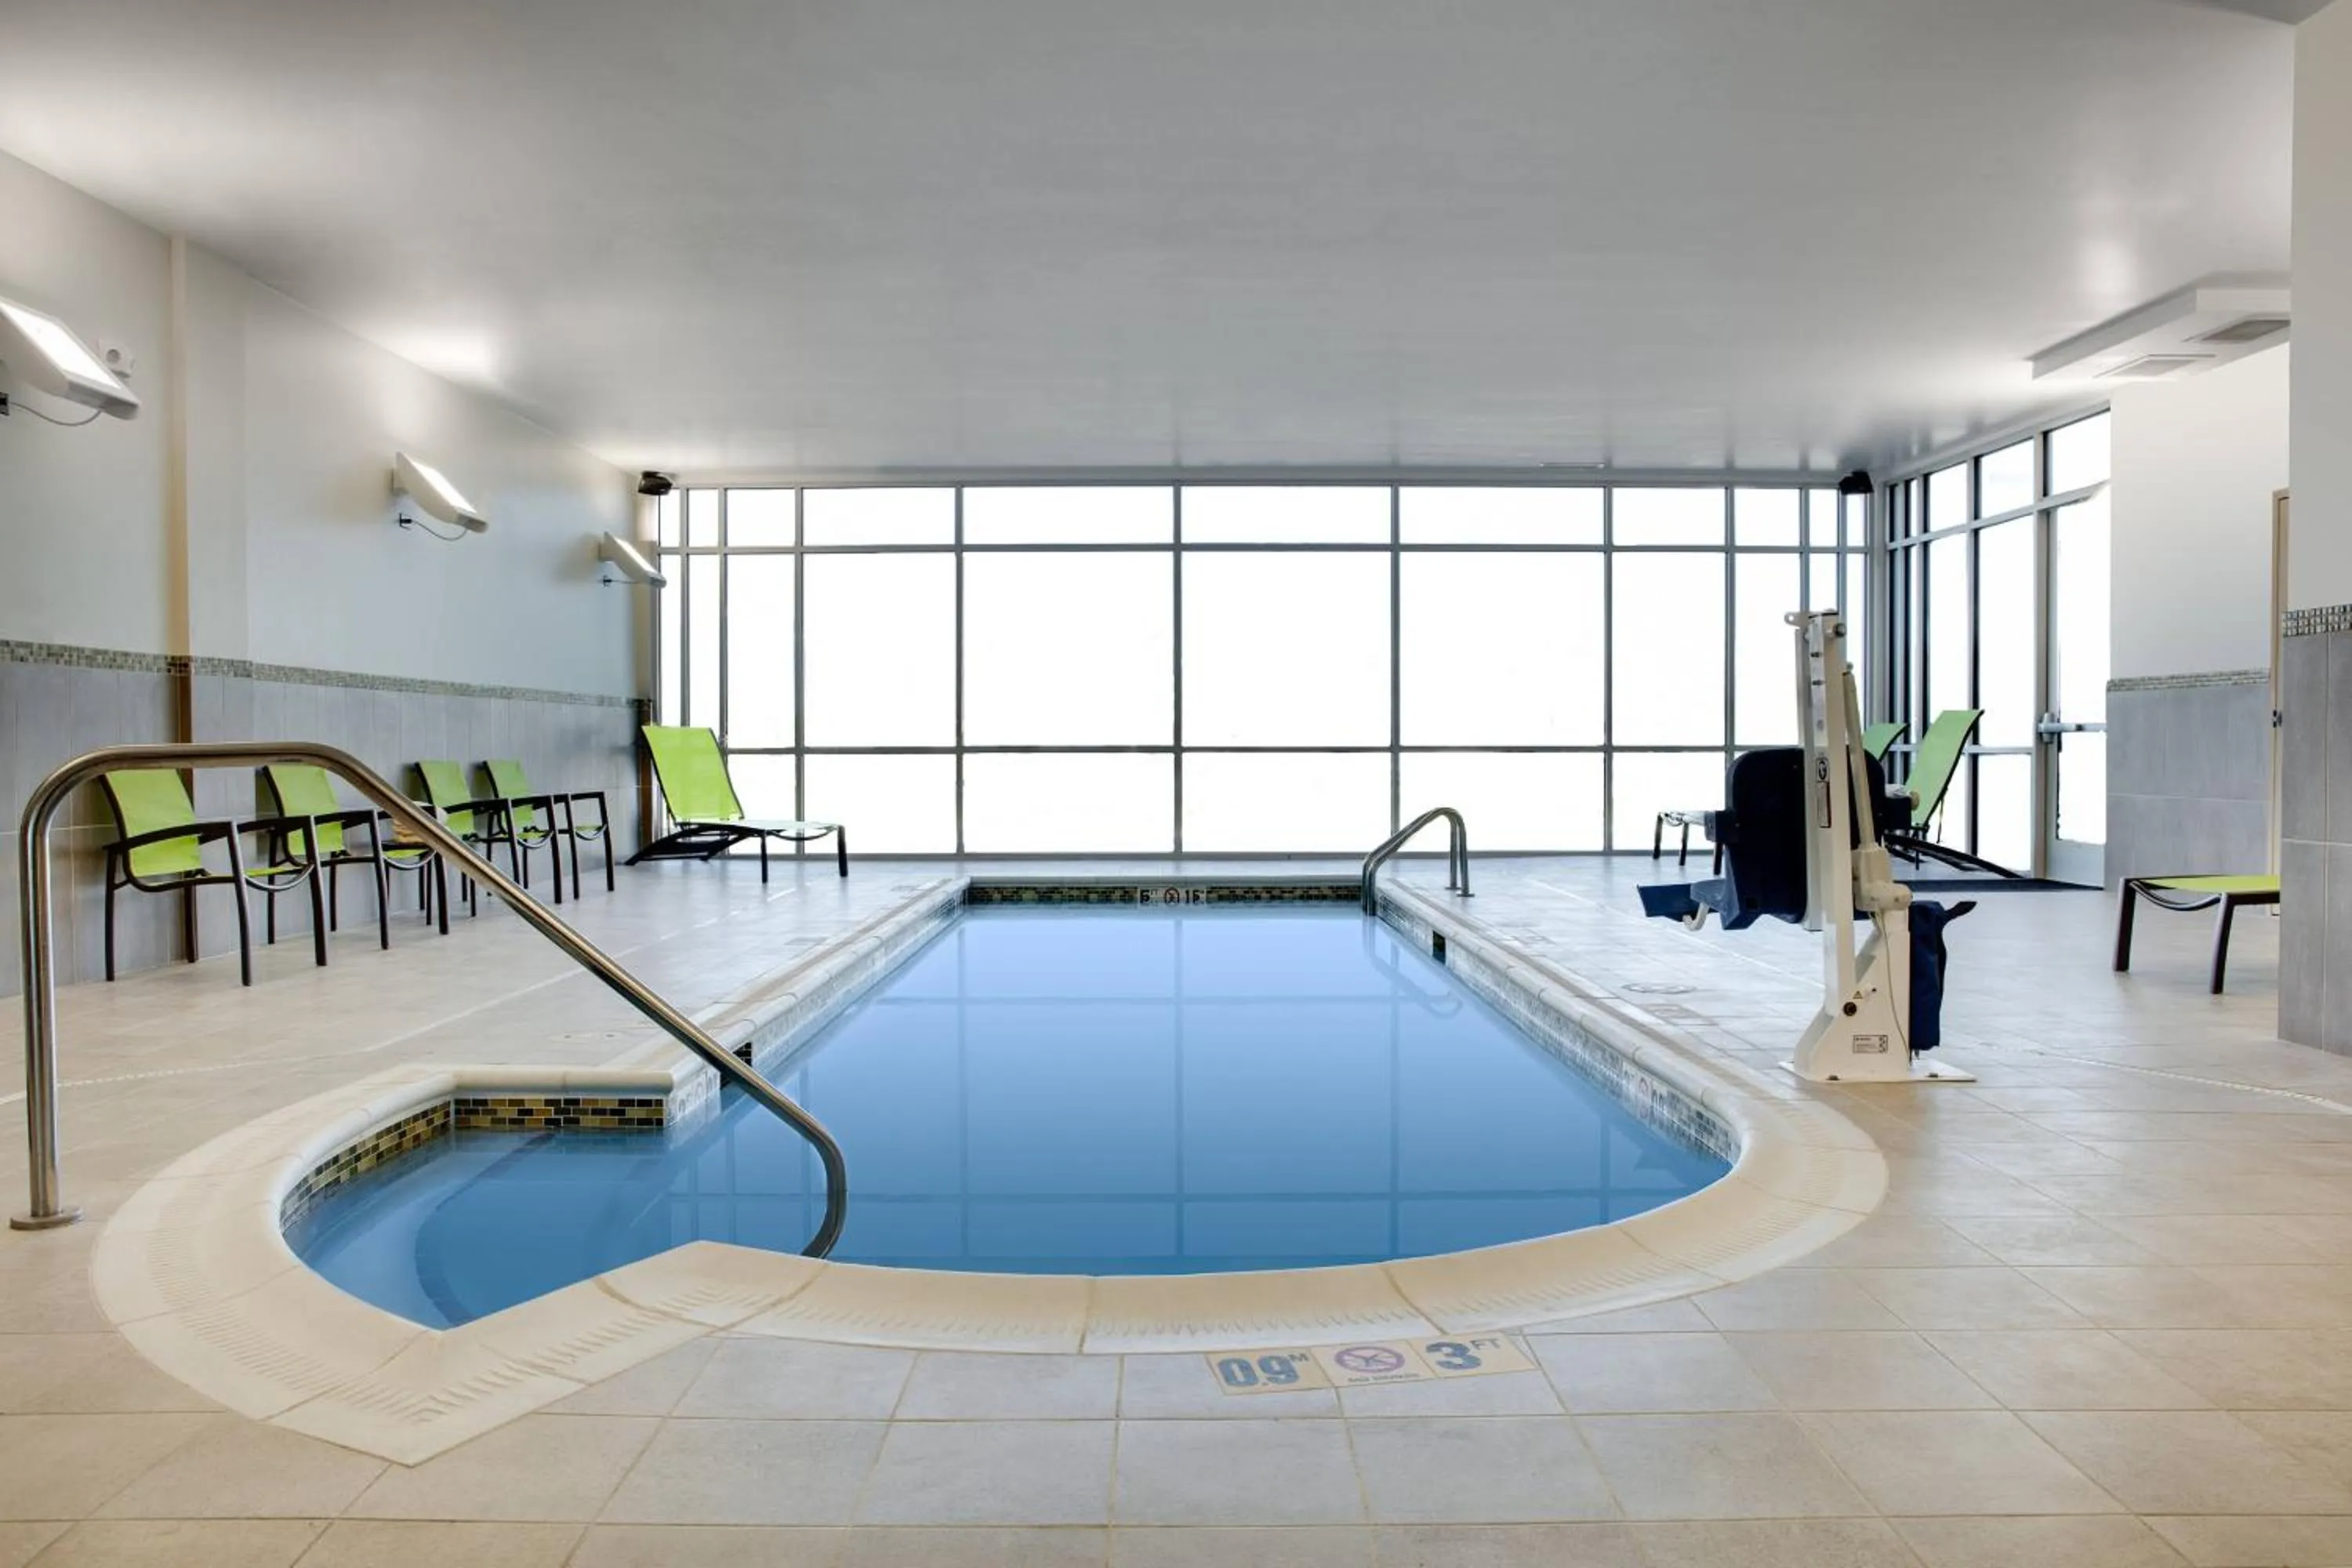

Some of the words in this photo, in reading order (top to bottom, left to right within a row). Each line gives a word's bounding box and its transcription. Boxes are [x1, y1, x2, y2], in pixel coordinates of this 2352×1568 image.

[1289, 1352, 1309, 1362] M
[1425, 1341, 1482, 1370] 3
[1469, 1338, 1501, 1350] FT
